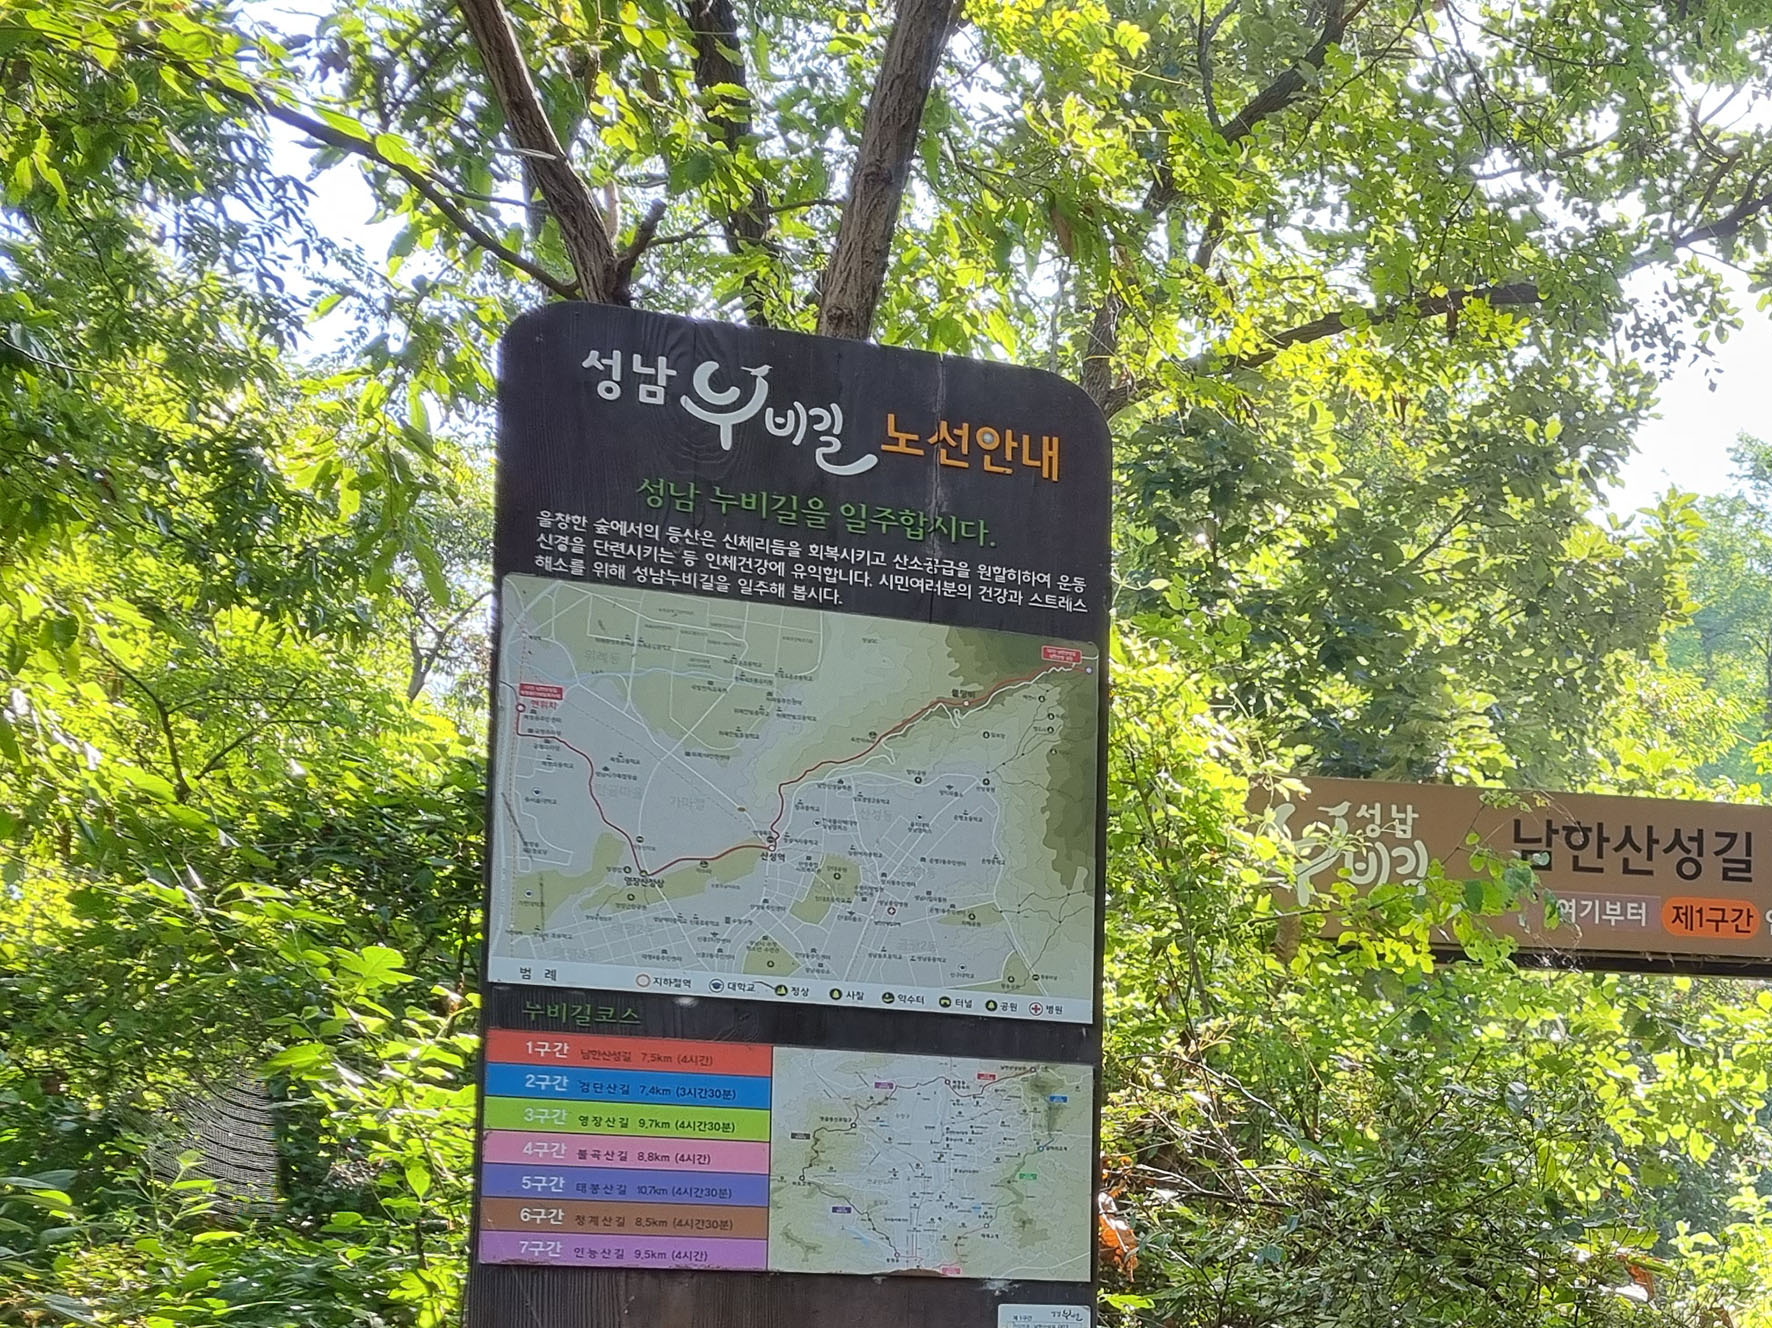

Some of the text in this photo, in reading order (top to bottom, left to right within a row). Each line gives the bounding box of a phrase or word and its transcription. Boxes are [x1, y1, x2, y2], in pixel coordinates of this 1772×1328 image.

[581, 350, 678, 405] 성남
[880, 412, 1060, 482] 노선안내
[636, 477, 997, 547] 성남 누비길을 일주합시다.
[592, 516, 660, 541] 숲에서의
[665, 526, 717, 548] 등산은
[722, 533, 802, 559] 신체리듬을
[807, 543, 887, 567] 회복시키고
[892, 553, 971, 579] 산소공급을
[1056, 573, 1087, 594] 운동
[533, 553, 843, 605] 해소를 위해 성남누비길을 일주해 봅시다.
[535, 532, 1089, 613] 신경을 단련시키는 등 인체건강에 유익합니다. 시민여러분의 건강과 스트레스
[1356, 802, 1419, 839] 성남
[760, 850, 786, 863] 산성역
[1513, 817, 1753, 883] 남한산성길
[1556, 897, 1648, 927] 여기부터
[1671, 903, 1754, 934] 제1구간
[652, 975, 692, 989] 지하철역
[727, 981, 756, 993] 대학교
[791, 986, 810, 998] 정상
[846, 990, 864, 1002] 사찰
[898, 994, 925, 1005] 약수터
[955, 997, 973, 1009] 터널
[999, 1001, 1018, 1012] 공원
[521, 1001, 642, 1027] 누비길코스
[1045, 1004, 1063, 1015] 병원
[525, 1041, 570, 1059] 1구간
[676, 1054, 713, 1067] (4시간)
[524, 1074, 569, 1092] 2구간
[578, 1082, 630, 1096] 검단산길
[675, 1086, 737, 1102] (3시간30분)
[523, 1107, 569, 1126] 3구간
[578, 1115, 630, 1129] 영장산길
[674, 1120, 736, 1134] (4시간30분)
[522, 1141, 567, 1159] 4구간
[674, 1153, 711, 1166] (4시간)
[521, 1175, 566, 1193] 5구간
[671, 1186, 733, 1200] (4시간30분)
[519, 1207, 565, 1225] 6구간
[672, 1218, 734, 1232] (4시간30분)
[519, 1240, 563, 1258] 7구간
[573, 1247, 625, 1260] 인능산길
[670, 1250, 708, 1263] (4시간)
